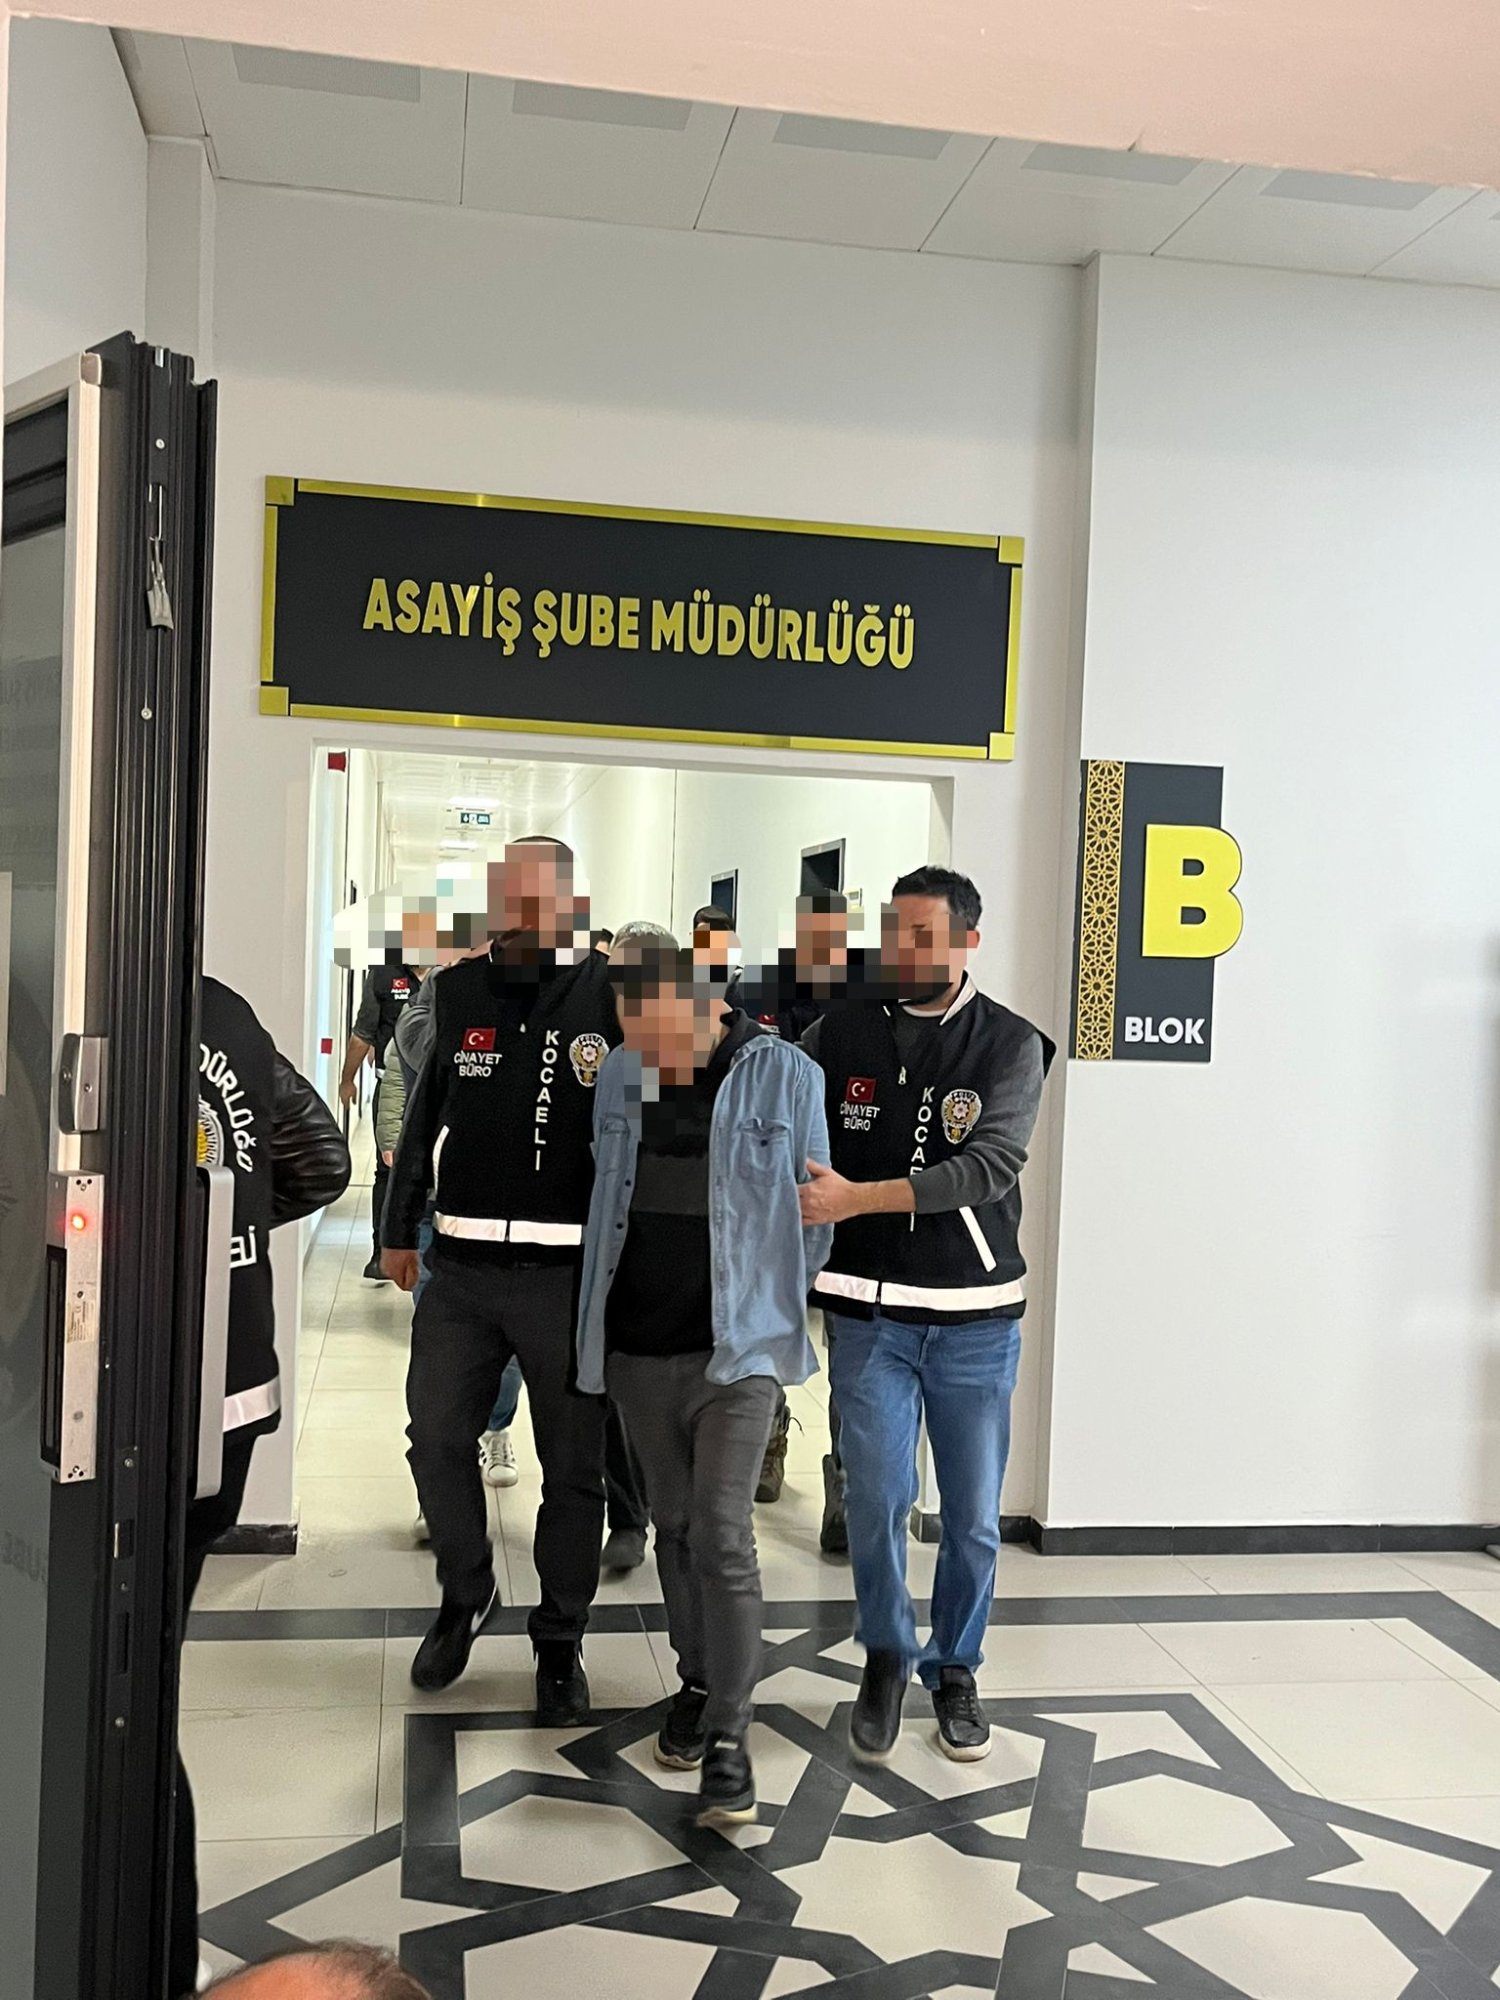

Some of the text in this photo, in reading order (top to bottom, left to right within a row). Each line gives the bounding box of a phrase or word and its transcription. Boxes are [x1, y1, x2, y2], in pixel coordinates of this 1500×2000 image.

[362, 571, 915, 669] ASAYİŞ ŞUBE MÜDÜRLÜĞÜ
[1141, 823, 1243, 959] B
[1124, 1016, 1205, 1045] BLOK
[459, 1063, 492, 1077] BÜRO
[843, 1115, 871, 1131] BÜRO
